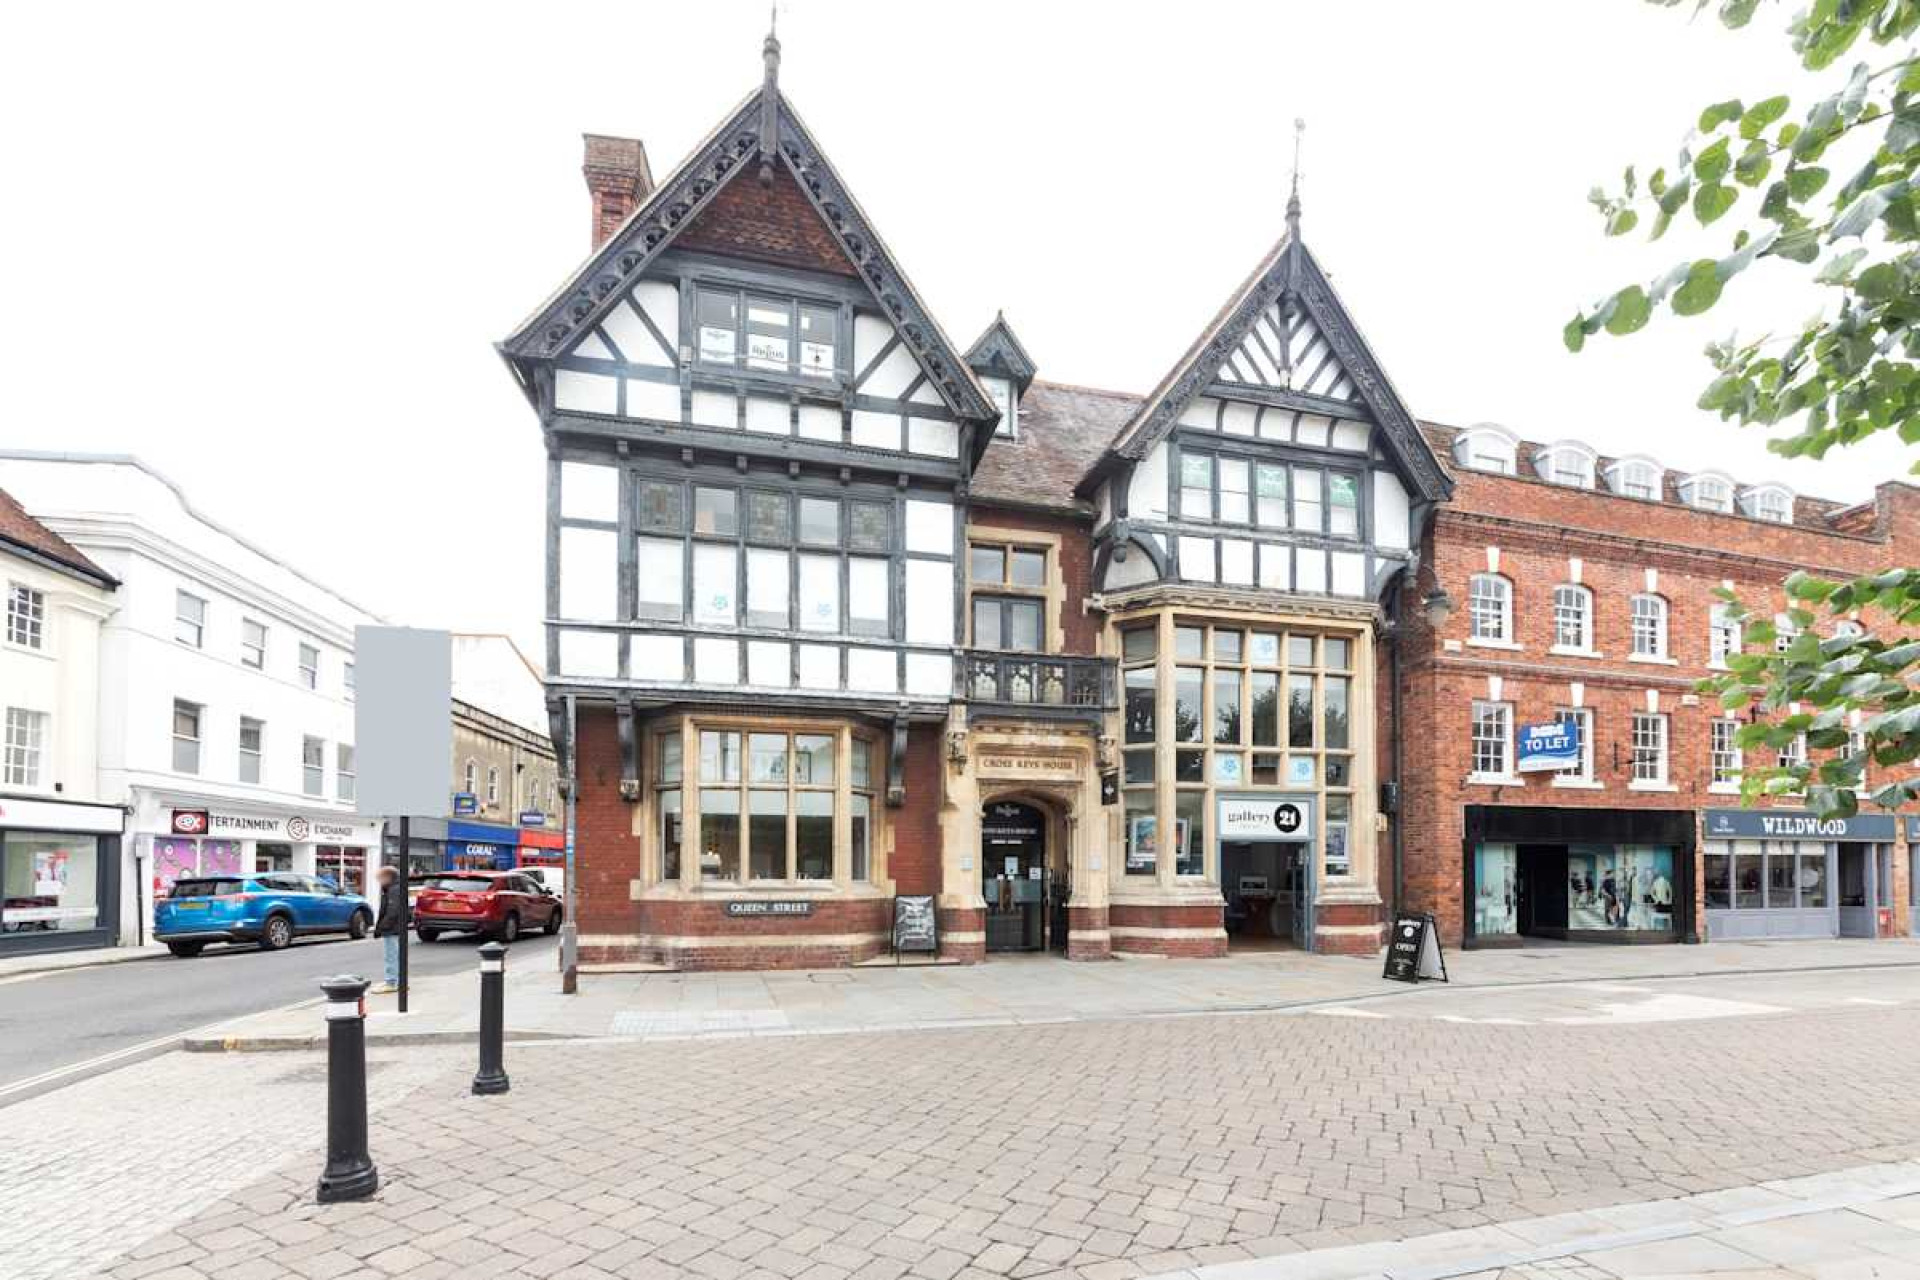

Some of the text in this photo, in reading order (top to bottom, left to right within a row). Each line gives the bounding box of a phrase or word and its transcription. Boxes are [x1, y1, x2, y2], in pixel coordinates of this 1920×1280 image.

[1524, 736, 1570, 751] TO LET
[983, 758, 1073, 769] CROSS KEYS HOUSE
[209, 815, 280, 832] TERTAINMENT
[1228, 809, 1298, 827] gallery 21
[1762, 817, 1847, 835] WILDWOOD
[466, 843, 493, 856] CORAL
[730, 902, 808, 912] QUEEN STREET
